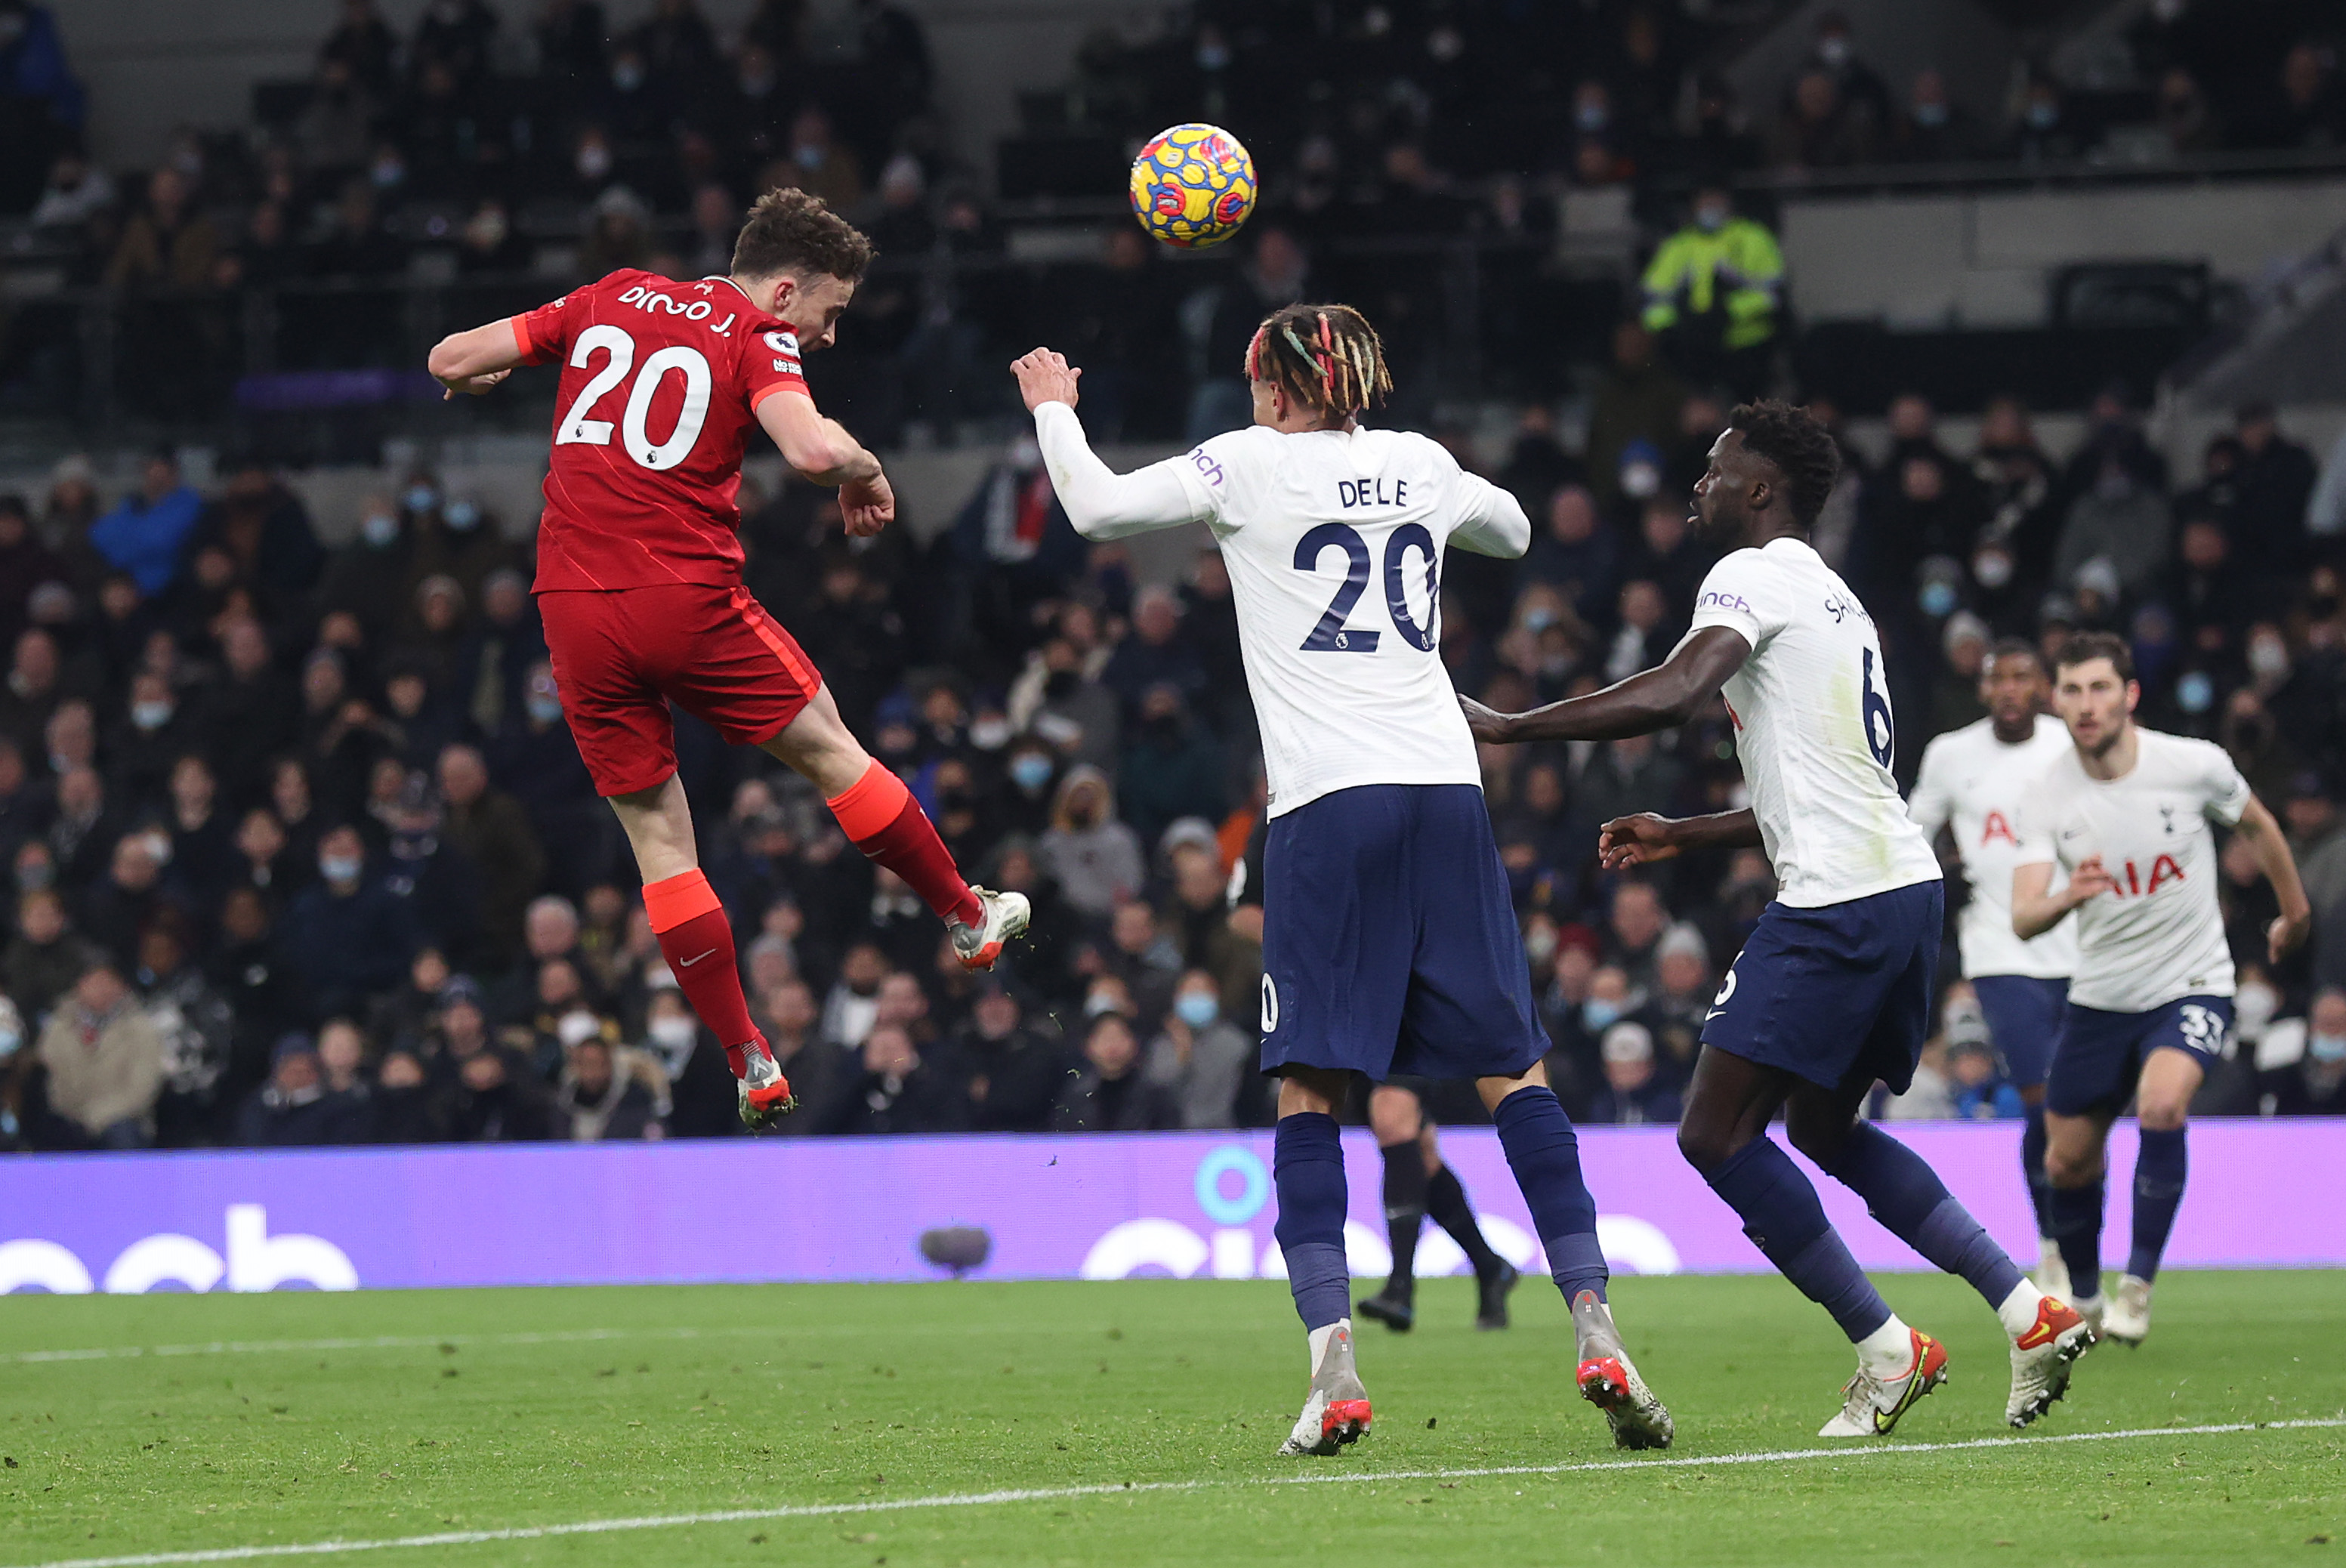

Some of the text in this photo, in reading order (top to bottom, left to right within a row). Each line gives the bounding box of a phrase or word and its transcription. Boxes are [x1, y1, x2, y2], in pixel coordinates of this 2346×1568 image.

[709, 313, 736, 338] J.
[555, 324, 712, 471] 20
[1338, 477, 1407, 509] DELE
[1293, 522, 1438, 653] 20
[1696, 591, 1751, 614] inch
[1861, 646, 1893, 769] 6
[2113, 853, 2186, 897] IA
[1261, 972, 1279, 1033] 0
